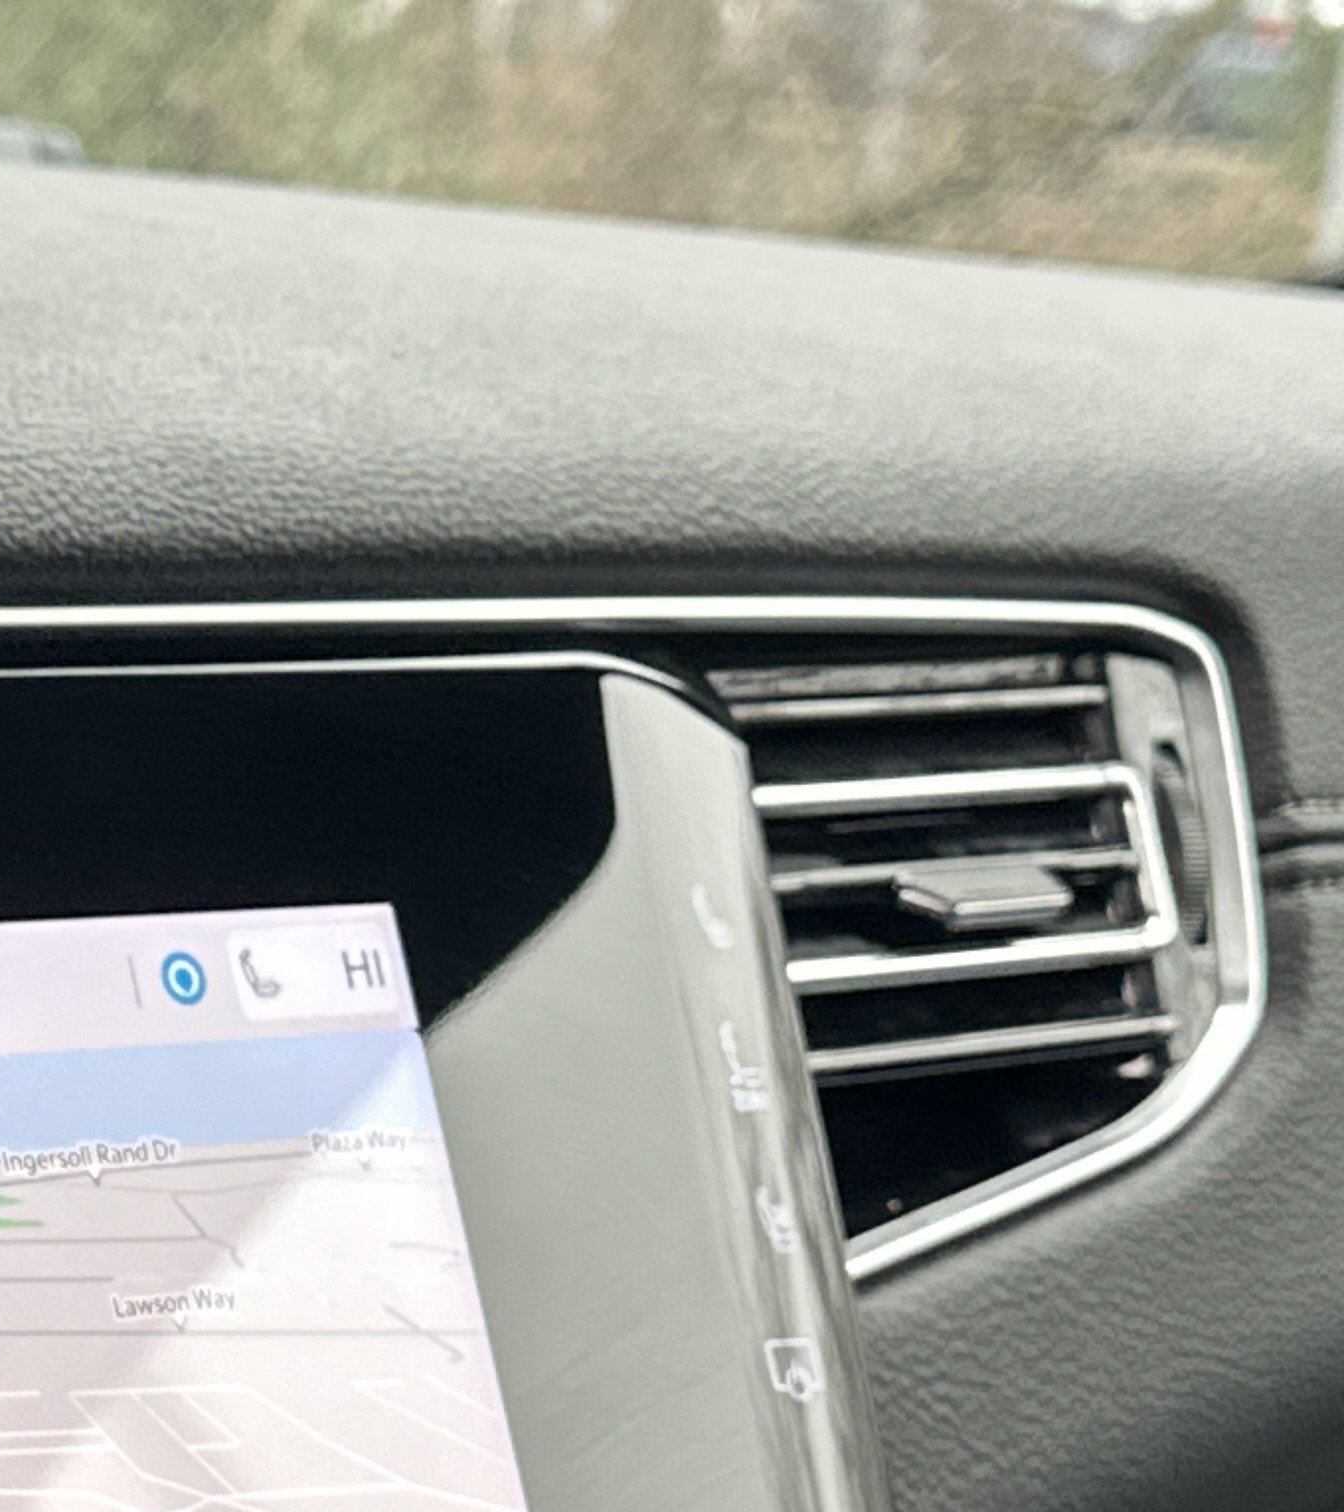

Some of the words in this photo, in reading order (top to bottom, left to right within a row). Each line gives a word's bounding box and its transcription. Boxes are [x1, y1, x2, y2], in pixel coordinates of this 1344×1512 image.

[341, 948, 387, 990] HI
[2, 1143, 92, 1176] Ingersoll
[97, 1142, 150, 1164] Rand
[154, 1139, 177, 1161] Dr
[366, 1130, 406, 1152] Way
[113, 1291, 189, 1319] Lawson
[192, 1288, 235, 1312] Way
